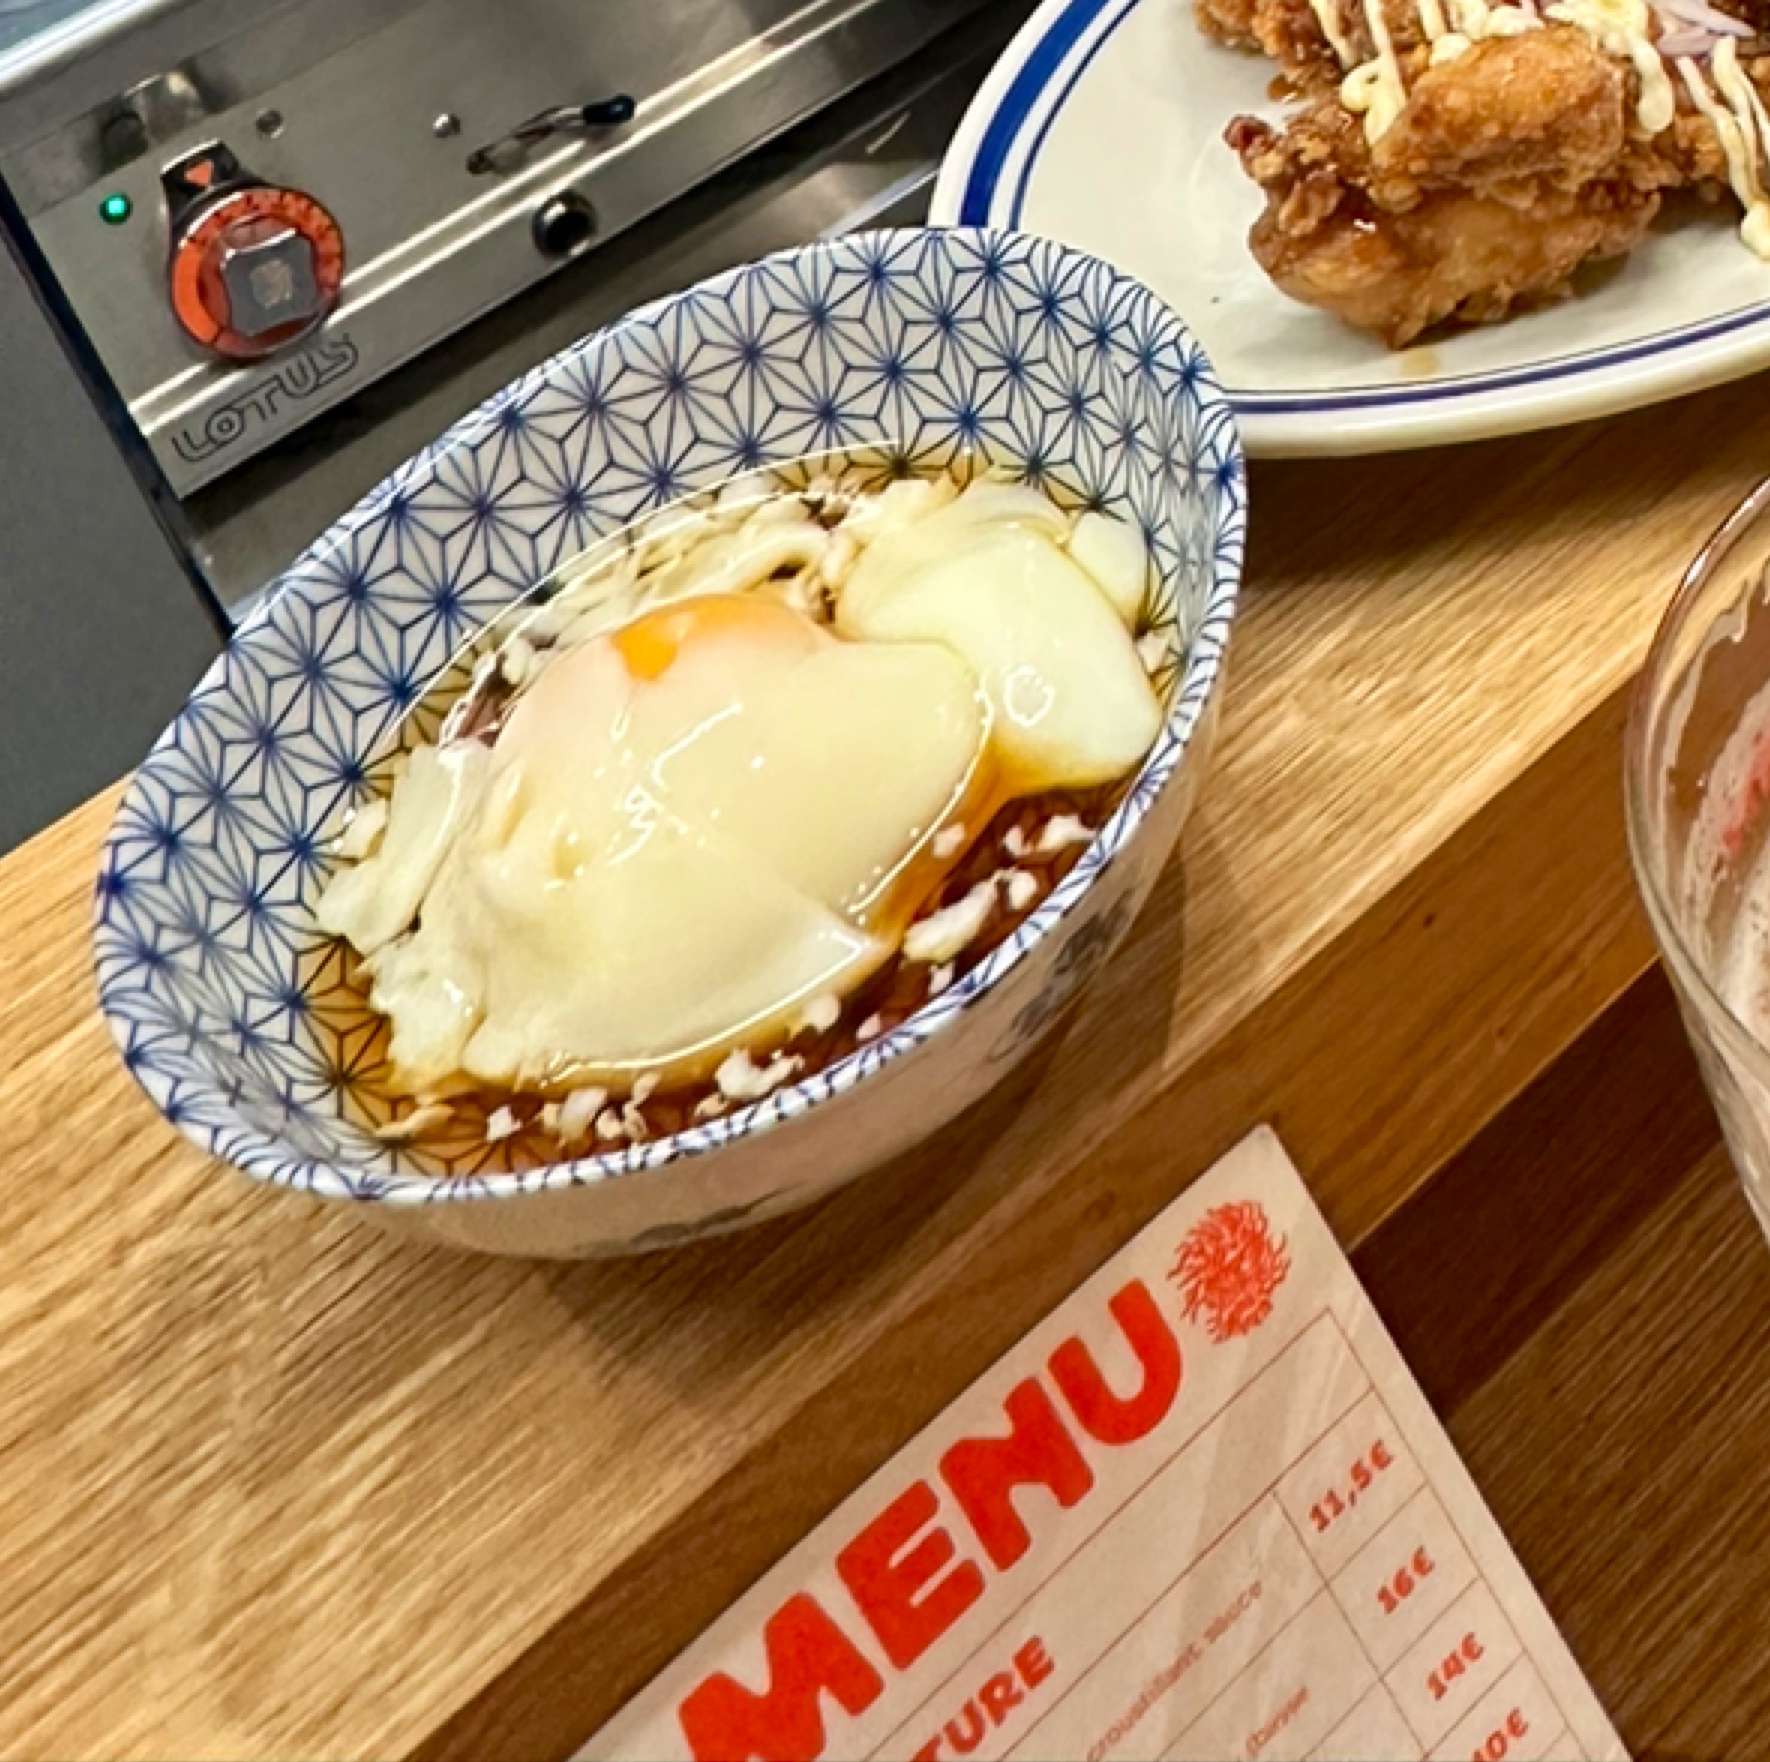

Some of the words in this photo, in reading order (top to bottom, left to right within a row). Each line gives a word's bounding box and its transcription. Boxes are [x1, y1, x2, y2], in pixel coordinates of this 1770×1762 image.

[171, 333, 359, 463] LOTUS
[679, 1279, 1182, 1762] MENU
[1309, 1439, 1393, 1533] 11,5€
[1378, 1546, 1435, 1614] 16€
[1426, 1632, 1484, 1701] 14€
